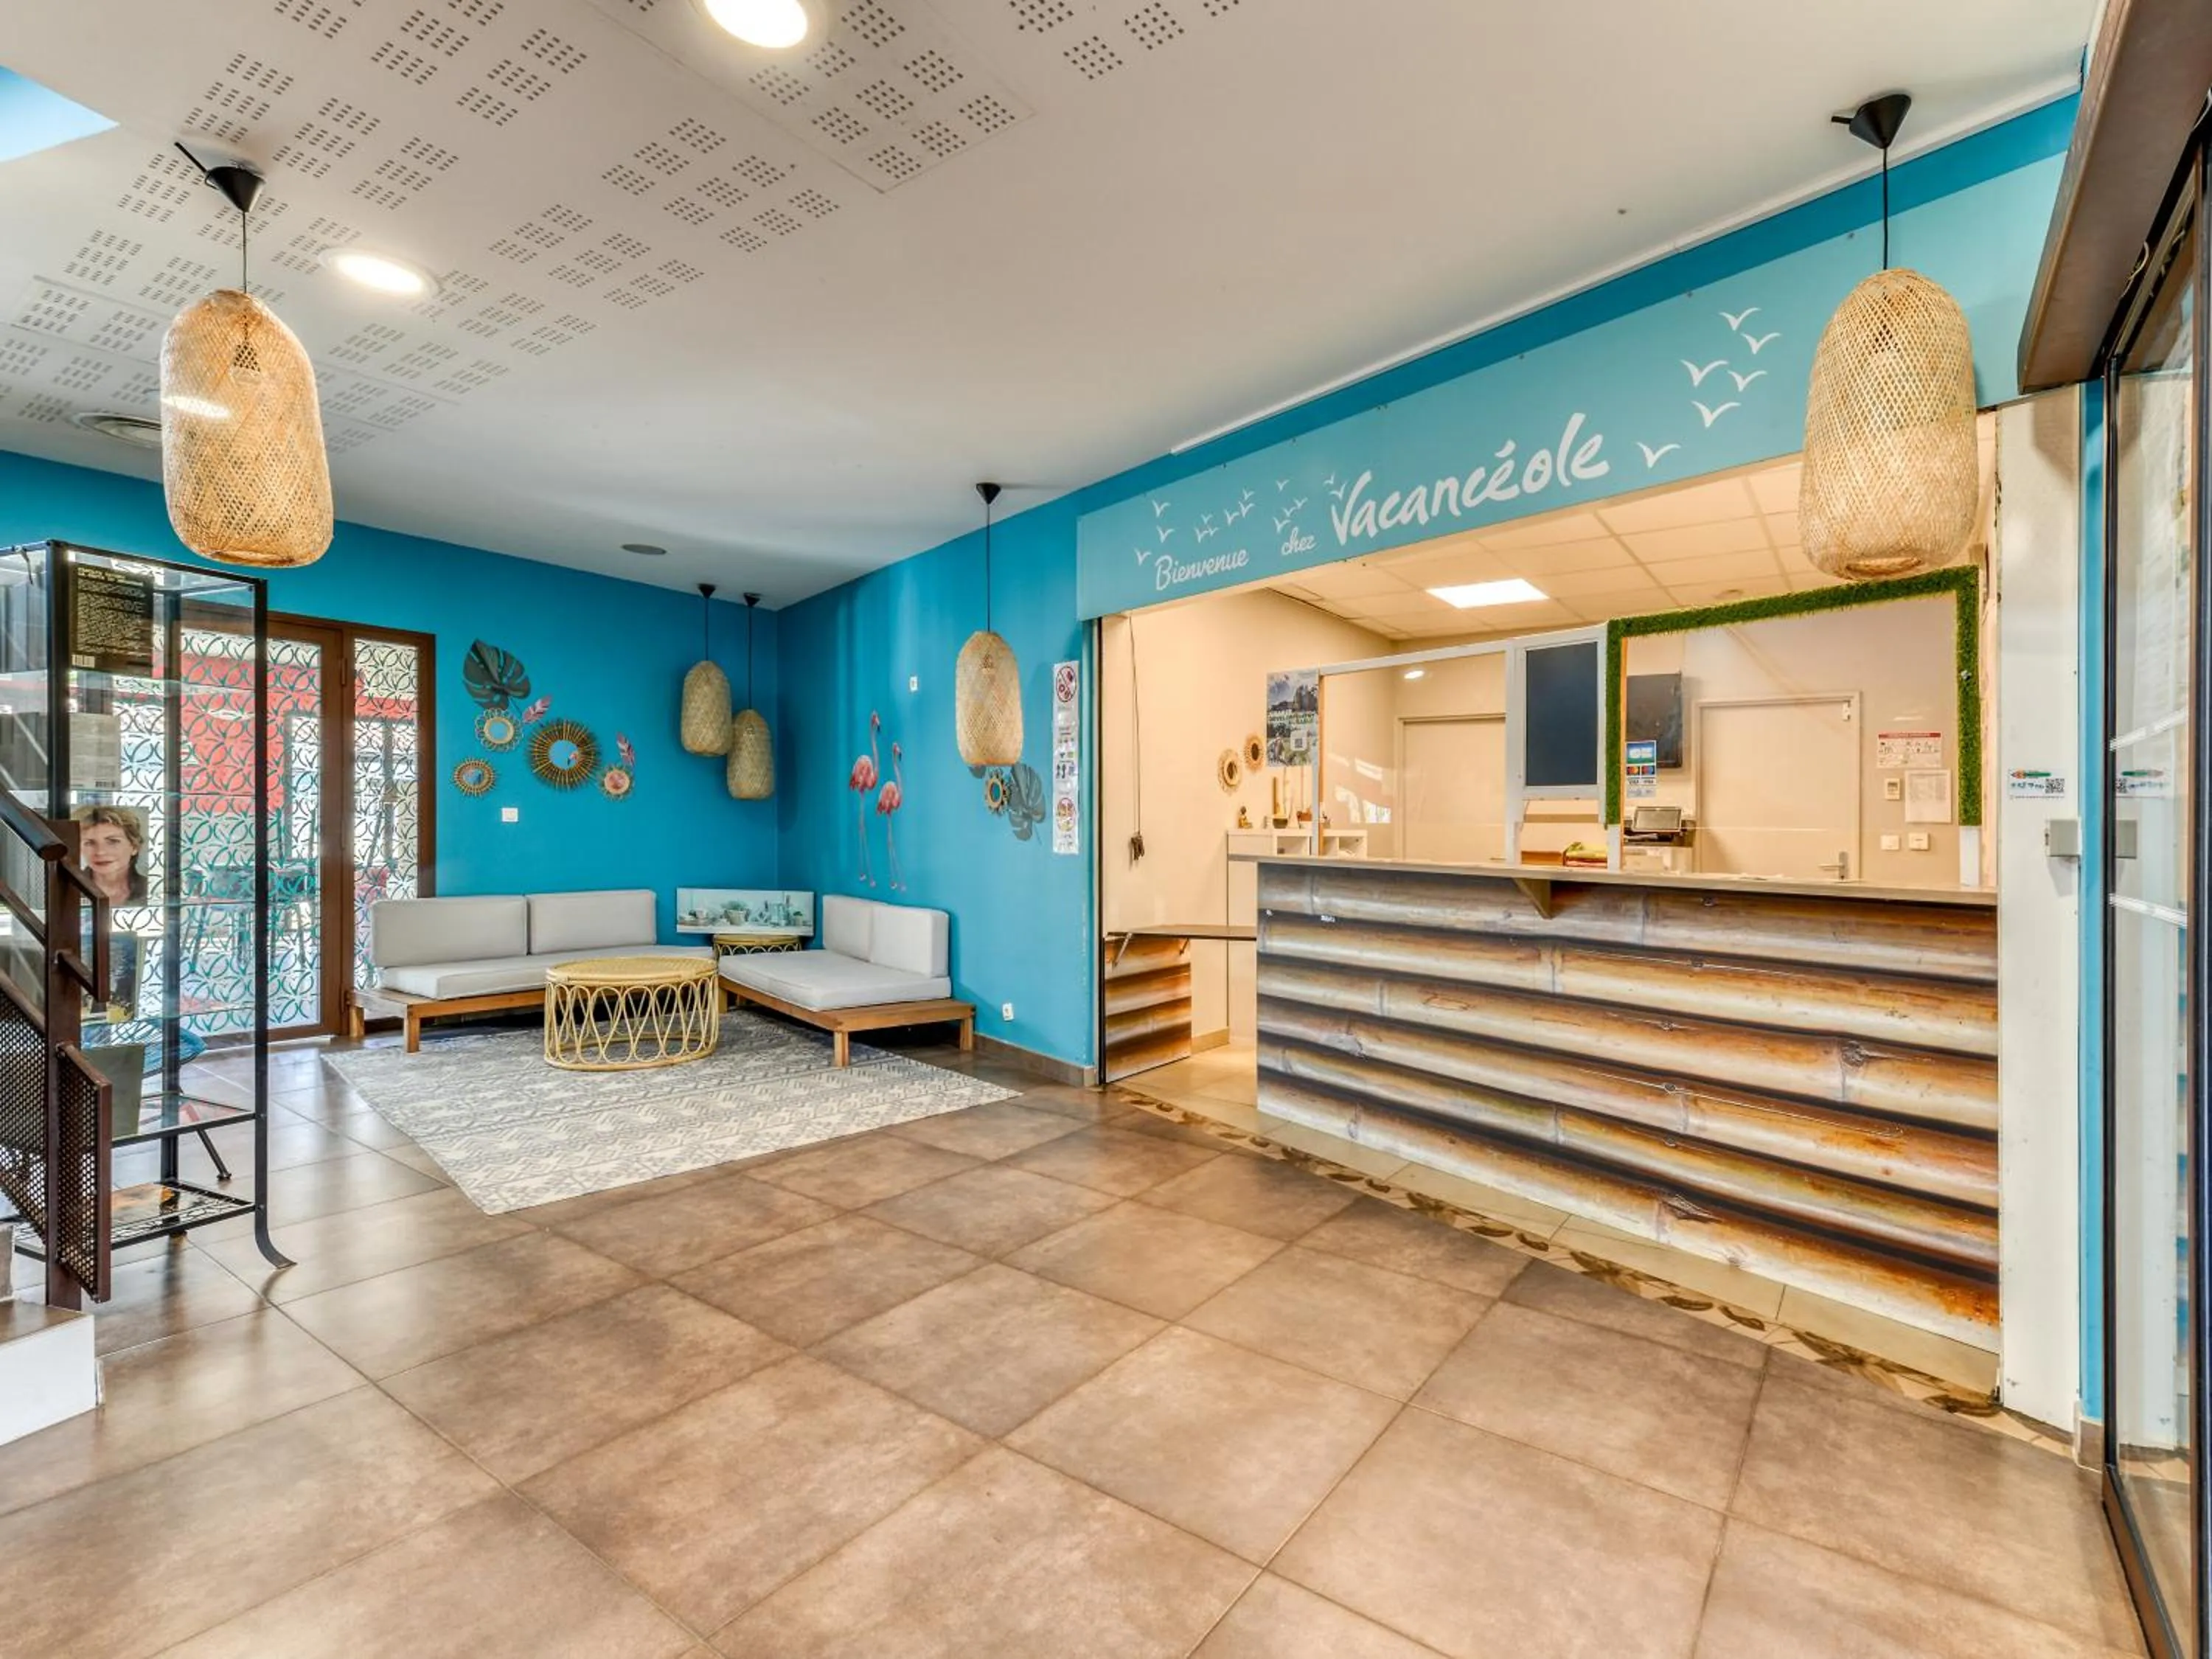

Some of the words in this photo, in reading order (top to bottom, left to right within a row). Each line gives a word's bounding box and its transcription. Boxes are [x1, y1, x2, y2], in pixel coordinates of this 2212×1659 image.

[1155, 549, 1249, 591] Bienvenue
[1281, 526, 1315, 555] chez
[1331, 413, 1610, 546] Vacancéole
